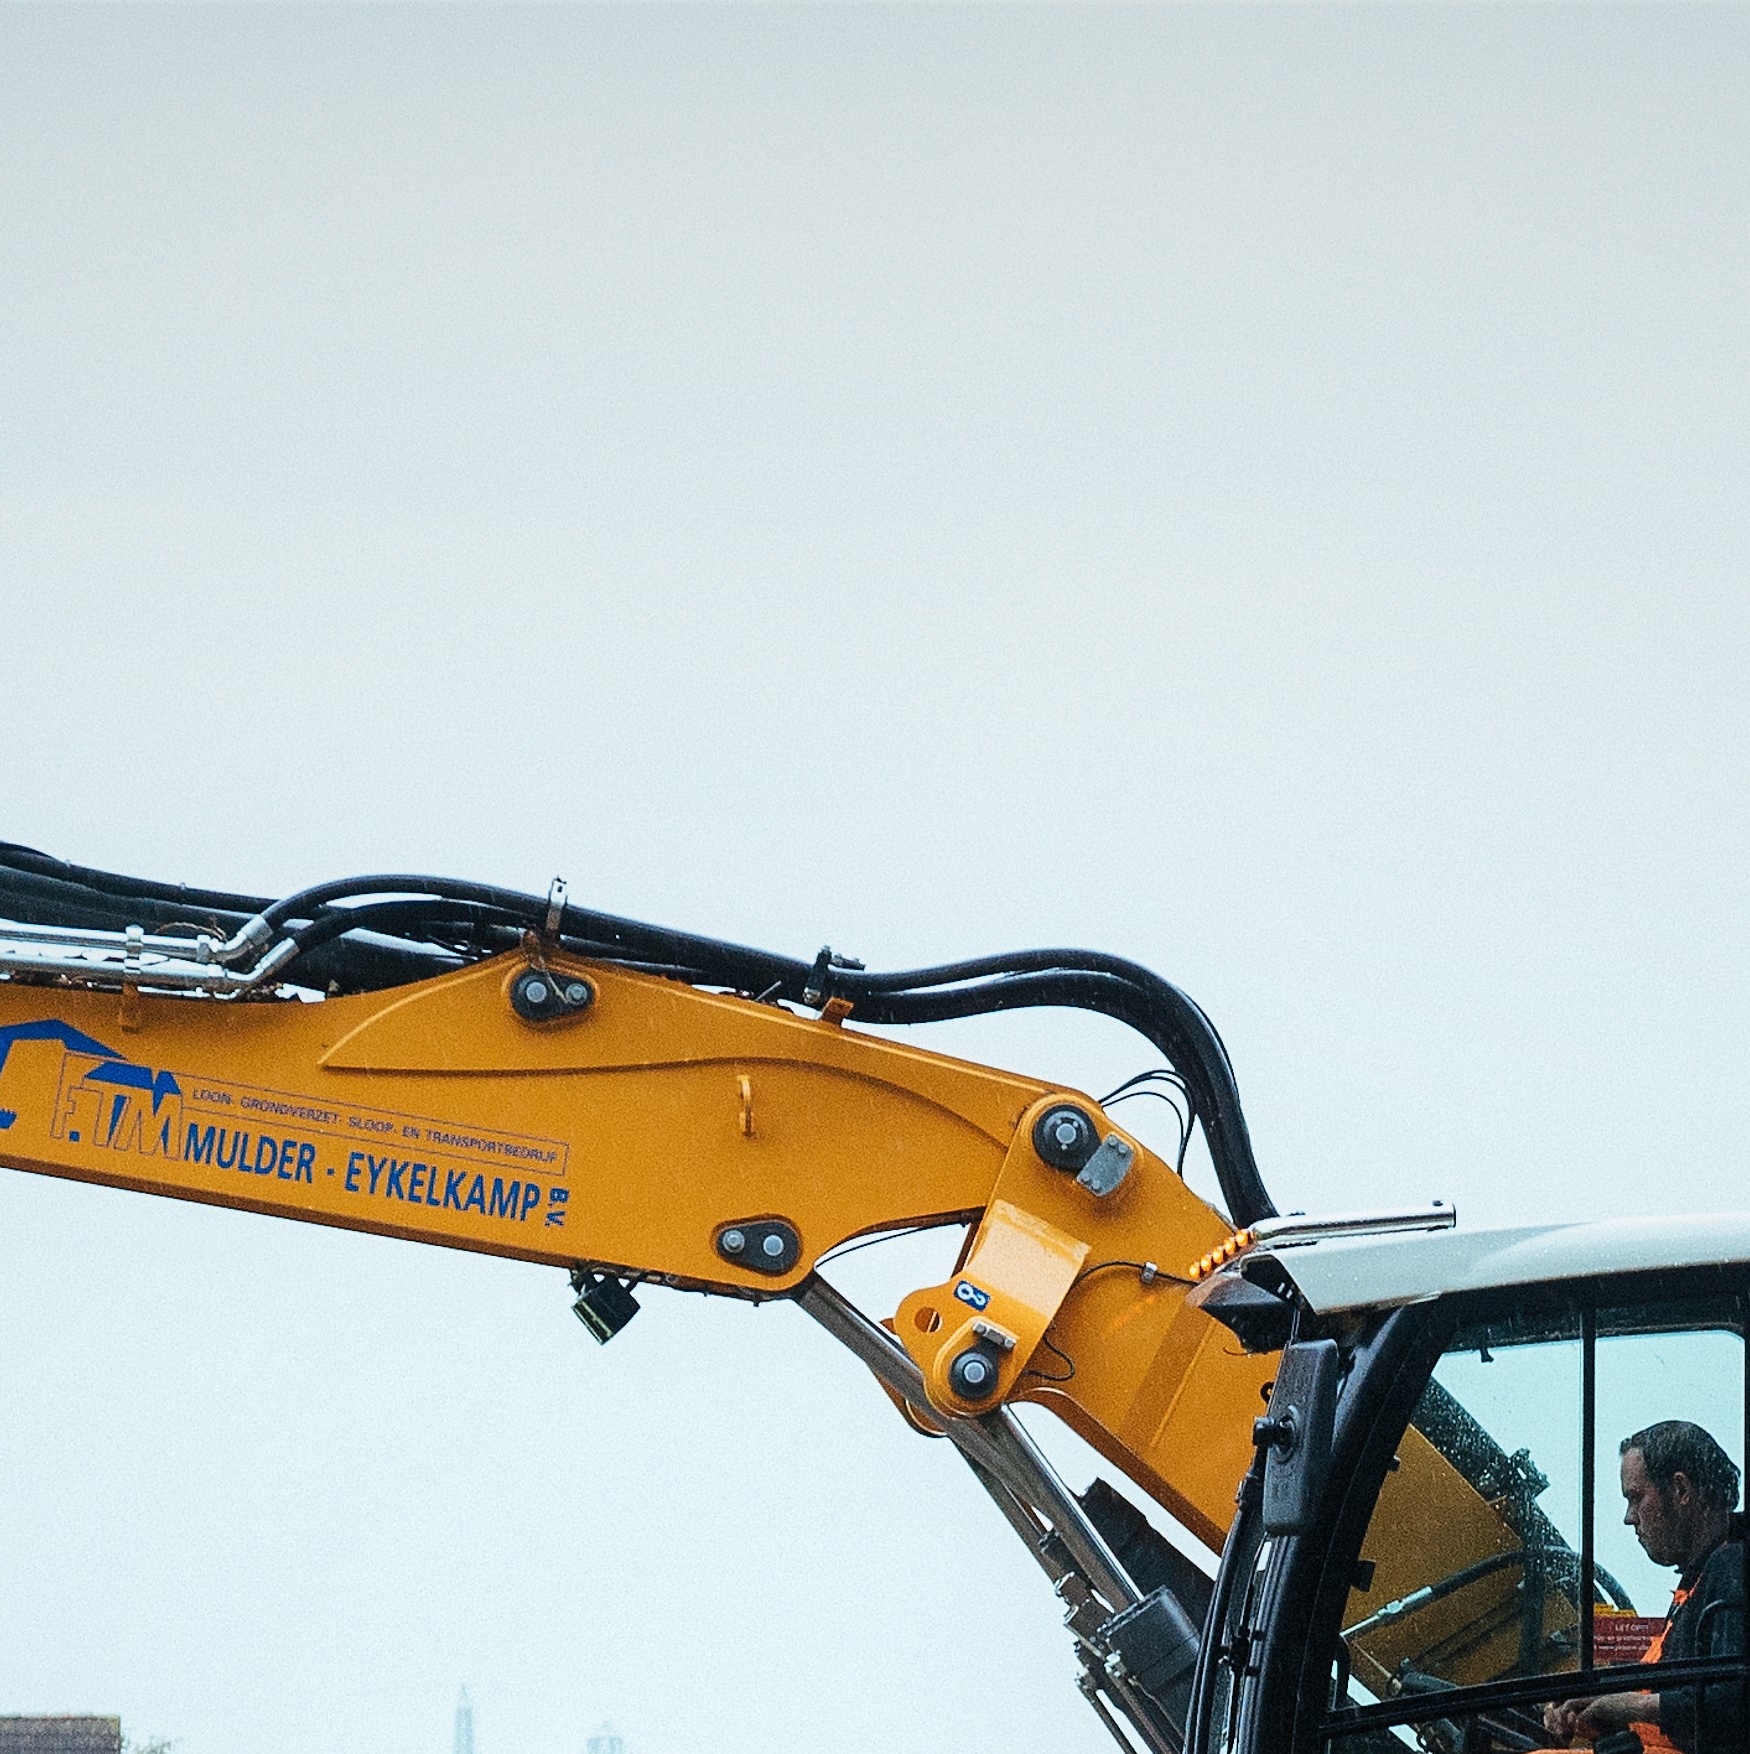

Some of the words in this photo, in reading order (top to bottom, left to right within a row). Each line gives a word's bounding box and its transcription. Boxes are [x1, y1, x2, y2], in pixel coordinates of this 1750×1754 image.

[183, 1122, 316, 1184] MULDER
[344, 1151, 541, 1221] EYKELKAMP
[402, 1125, 420, 1139] EN
[425, 1128, 558, 1164] TRANSPORTBEDRIJF
